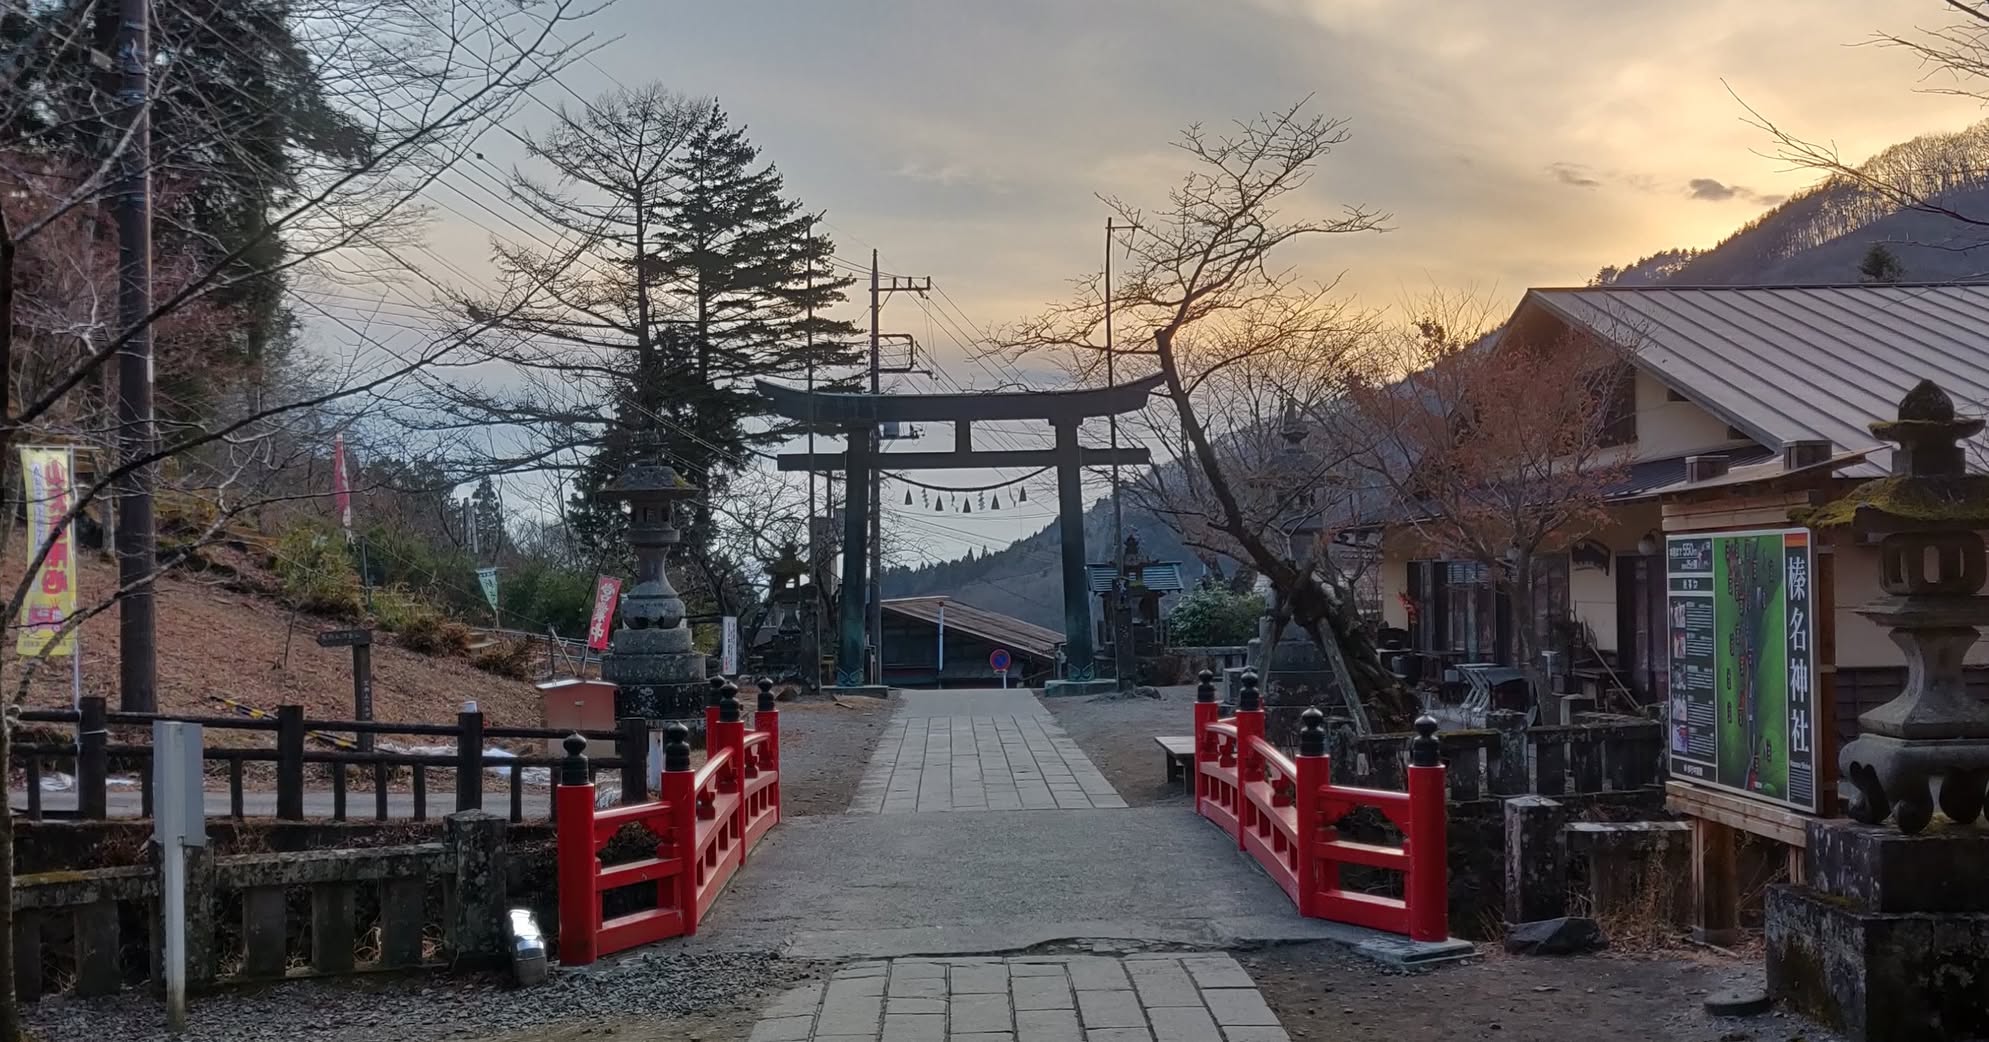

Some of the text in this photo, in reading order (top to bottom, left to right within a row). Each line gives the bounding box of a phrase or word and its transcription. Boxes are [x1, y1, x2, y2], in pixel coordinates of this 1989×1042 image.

[591, 583, 616, 643] 営業中
[1787, 556, 1809, 753] 榛名神社
